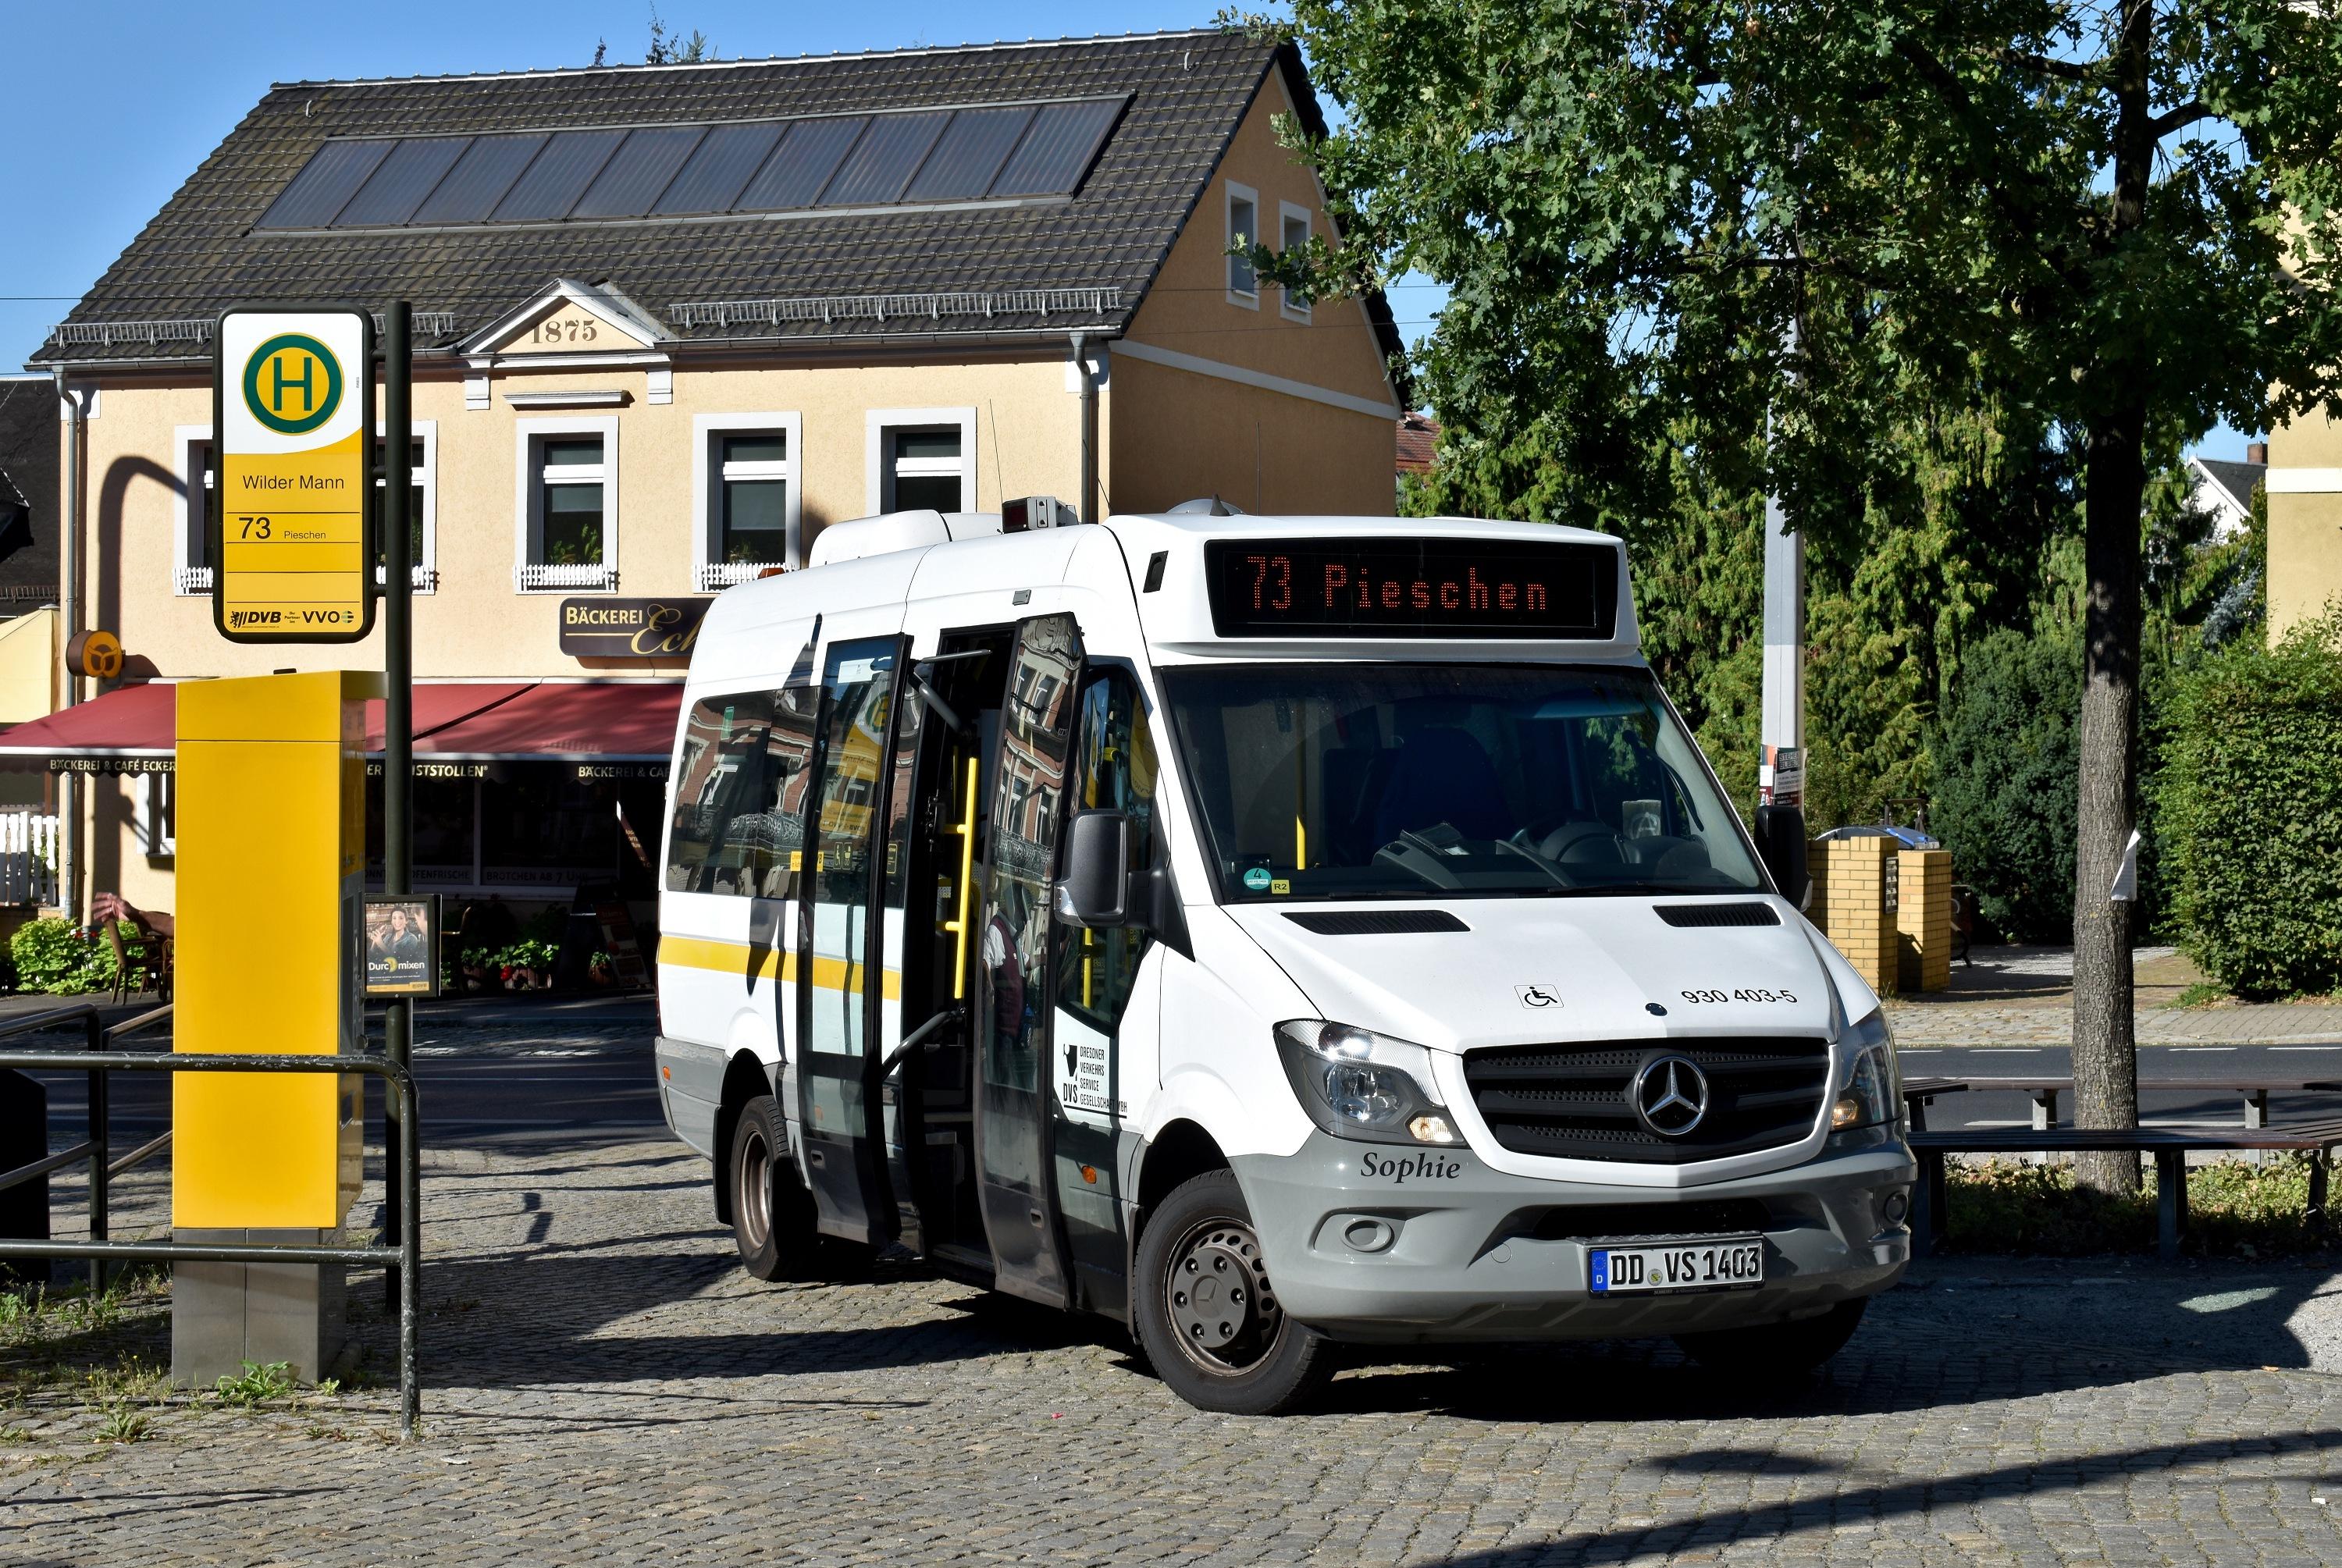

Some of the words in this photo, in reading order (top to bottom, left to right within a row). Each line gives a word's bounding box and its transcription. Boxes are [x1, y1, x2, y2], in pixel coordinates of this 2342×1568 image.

[531, 319, 597, 344] 1875
[273, 357, 312, 411] H
[243, 475, 294, 489] Wilder
[300, 475, 344, 489] Mann
[238, 517, 272, 539] 73
[284, 530, 326, 539] Pieschen
[1248, 556, 1290, 610] 73
[1326, 564, 1547, 610] Pieschen
[248, 611, 282, 624] DVB
[302, 610, 340, 623] VVO
[566, 606, 642, 624] BÄCKEREI
[50, 759, 100, 770] BÄCKEREI
[104, 761, 111, 770] &
[115, 758, 140, 771] CAFÉ
[578, 765, 634, 778] BÄCKEREI
[556, 873, 563, 883] 7
[1253, 869, 1262, 879] 4
[1681, 989, 1728, 1004] 930
[1734, 989, 1798, 1003] 403-5
[1080, 1046, 1105, 1061] DRESDNER
[1080, 1061, 1105, 1076] VERKEHRS
[1080, 1077, 1100, 1092] SERVICE
[1063, 1083, 1078, 1104] DVS
[1080, 1093, 1115, 1111] GESELLSCHAFT
[1360, 1151, 1461, 1184] Sophie
[1611, 1253, 1645, 1285] DD
[1664, 1250, 1696, 1283] VS
[1702, 1246, 1760, 1281] 1403
[1596, 1275, 1603, 1284] D
